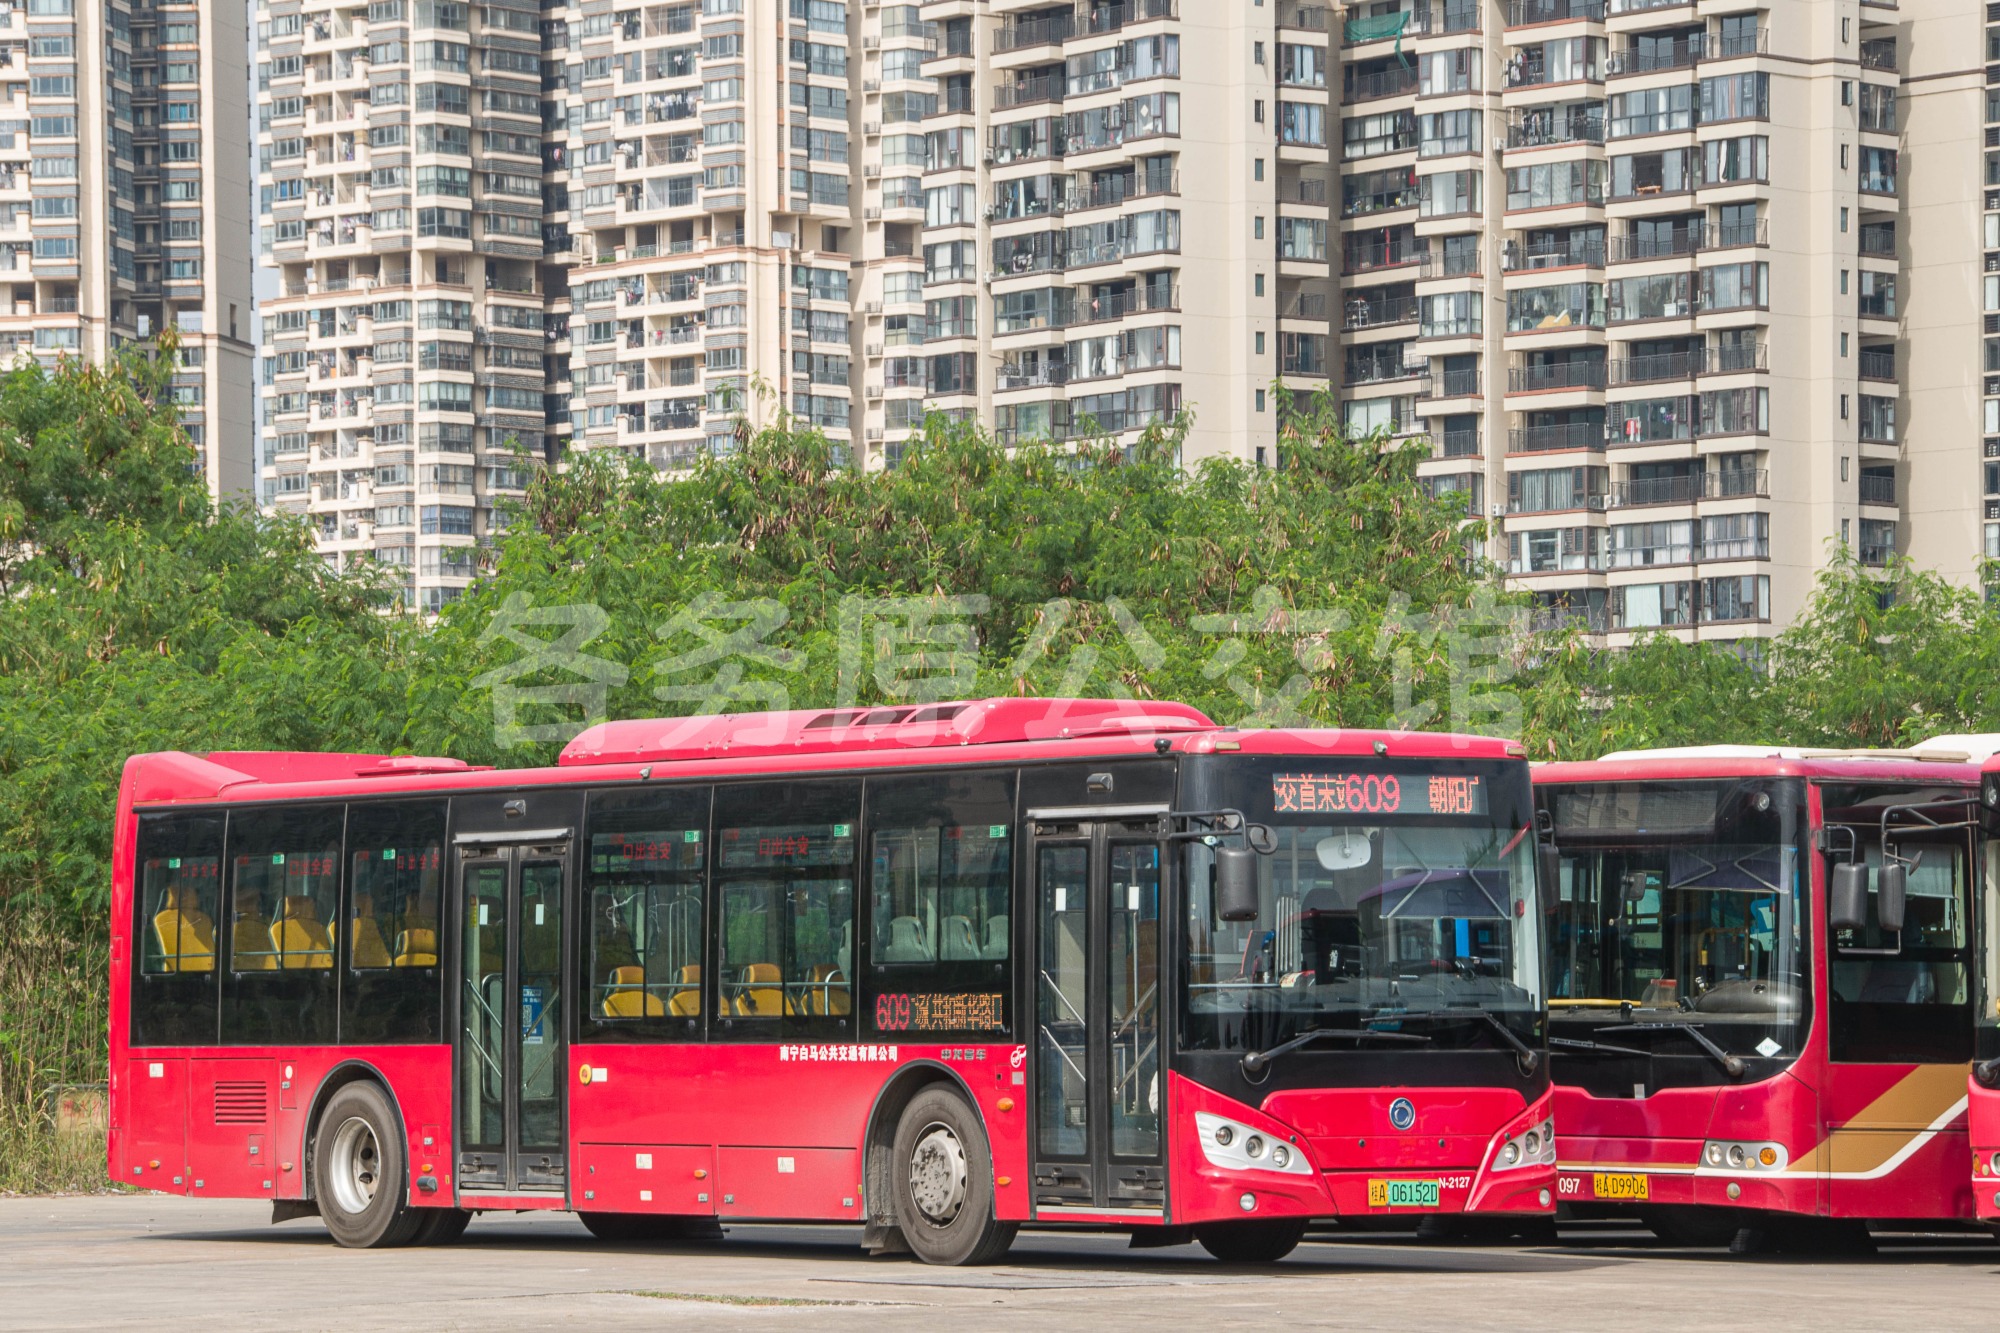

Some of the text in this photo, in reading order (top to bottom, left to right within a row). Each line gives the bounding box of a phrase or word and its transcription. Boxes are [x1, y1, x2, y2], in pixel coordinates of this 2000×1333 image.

[1345, 774, 1400, 812] 609
[876, 993, 911, 1031] 609
[779, 1045, 898, 1062] 南宁白马公共交通有限公司
[1438, 1177, 1471, 1189] N-2127
[1558, 1177, 1580, 1194] 097
